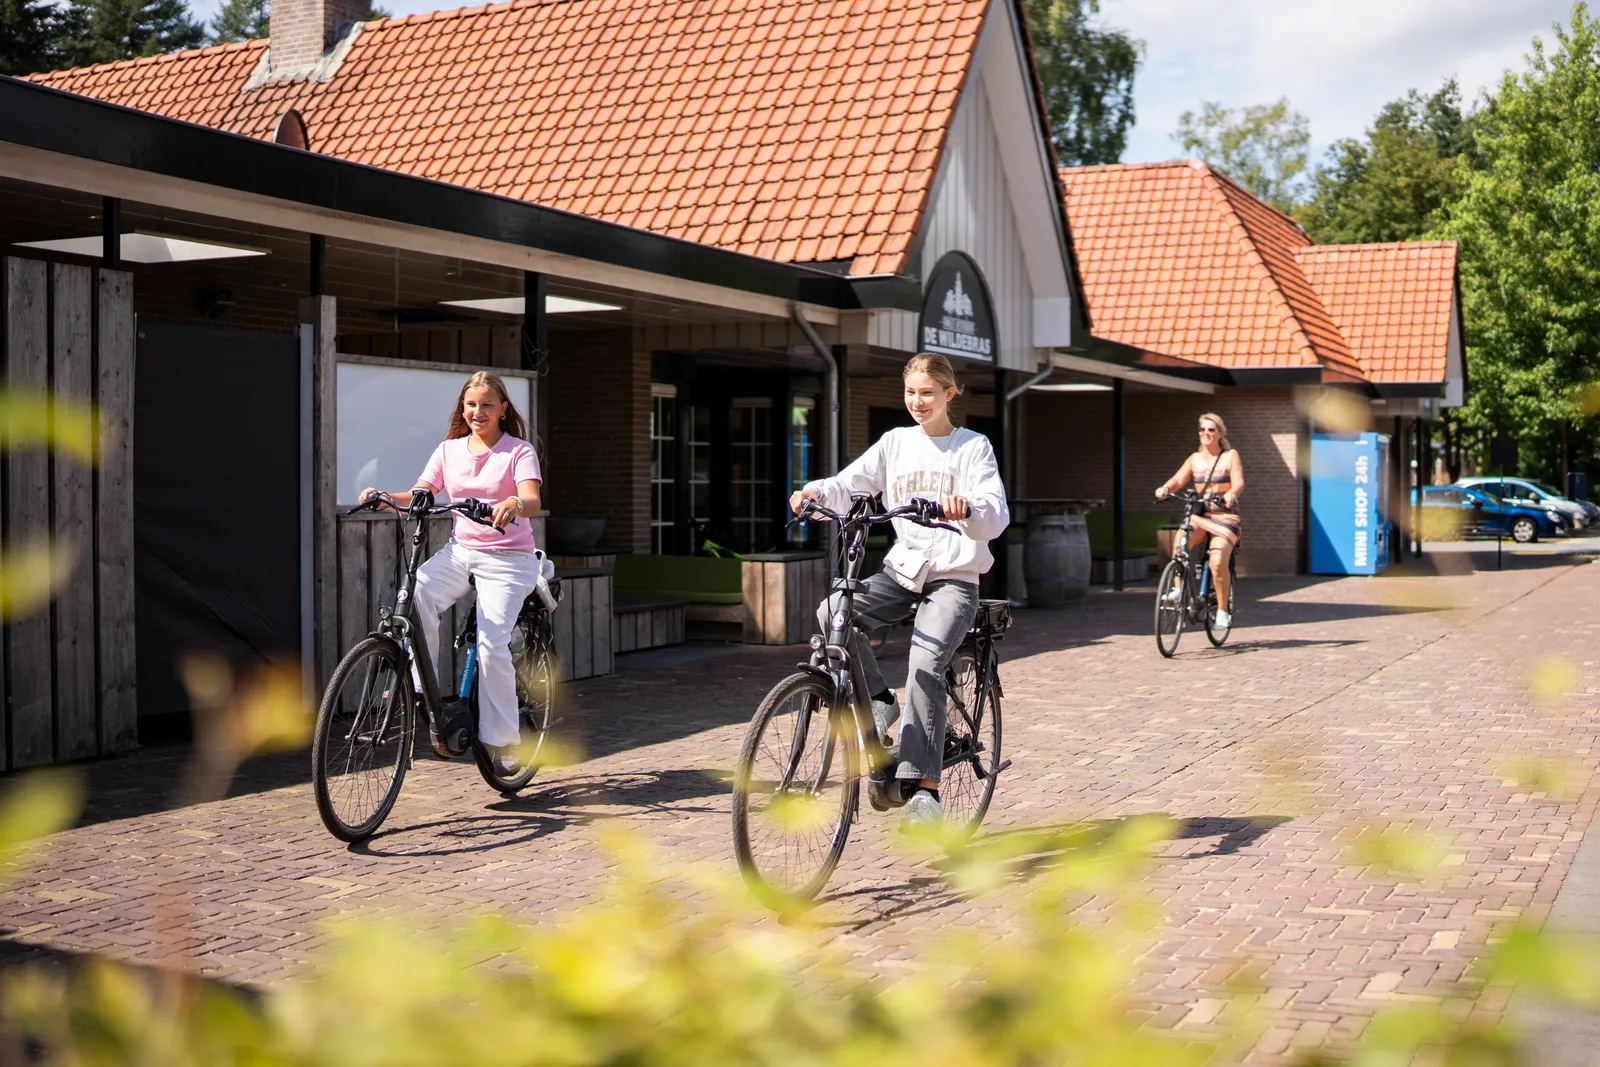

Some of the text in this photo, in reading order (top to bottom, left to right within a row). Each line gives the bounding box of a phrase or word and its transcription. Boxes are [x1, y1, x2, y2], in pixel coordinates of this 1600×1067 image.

[924, 326, 937, 345] DE
[1355, 455, 1368, 484] 24h
[1355, 487, 1368, 528] SHOP
[1354, 531, 1368, 567] MINI
